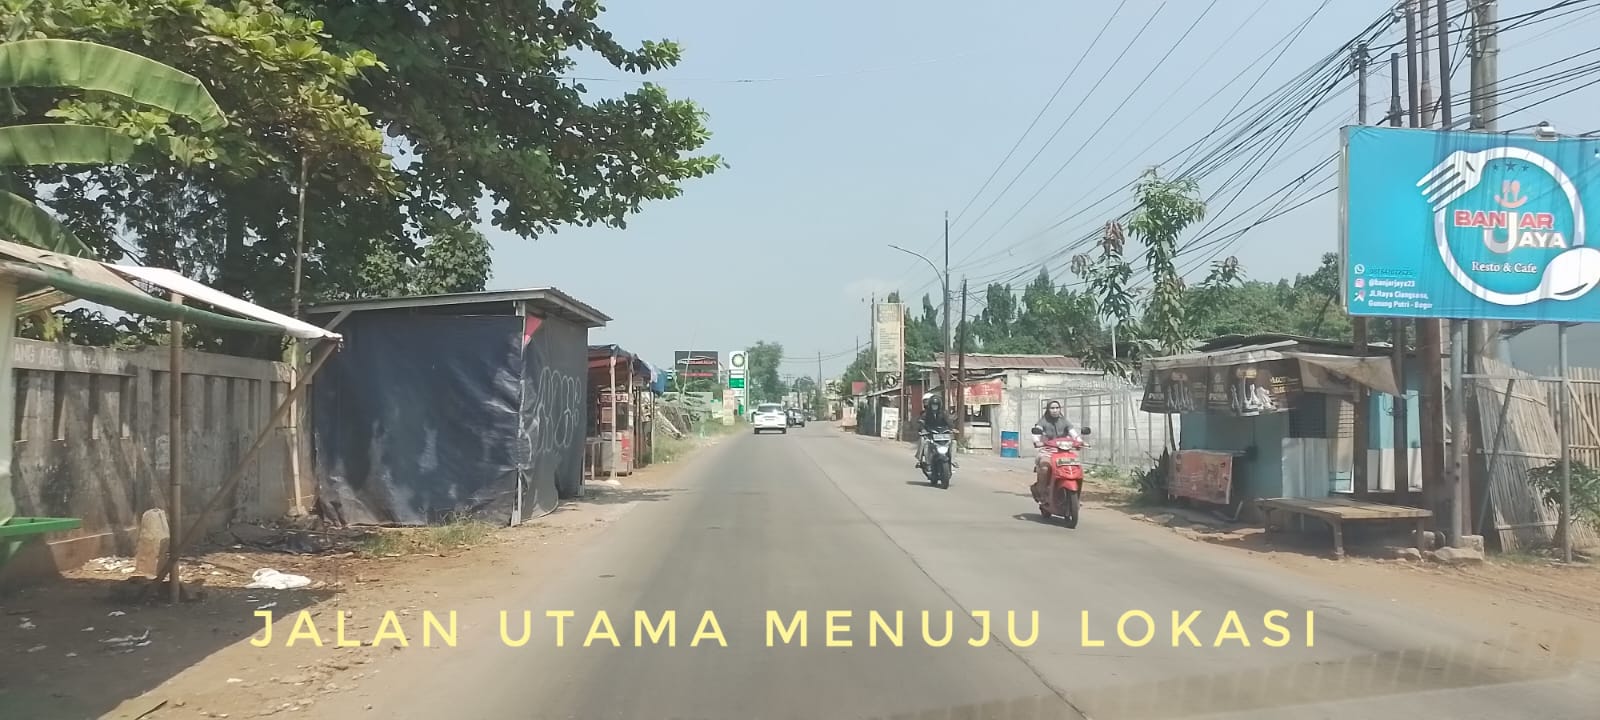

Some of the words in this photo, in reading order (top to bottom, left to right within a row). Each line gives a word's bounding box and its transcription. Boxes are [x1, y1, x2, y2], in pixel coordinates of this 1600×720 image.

[1472, 262, 1500, 272] Resto
[1503, 262, 1511, 272] &
[1514, 263, 1537, 273] Cafe
